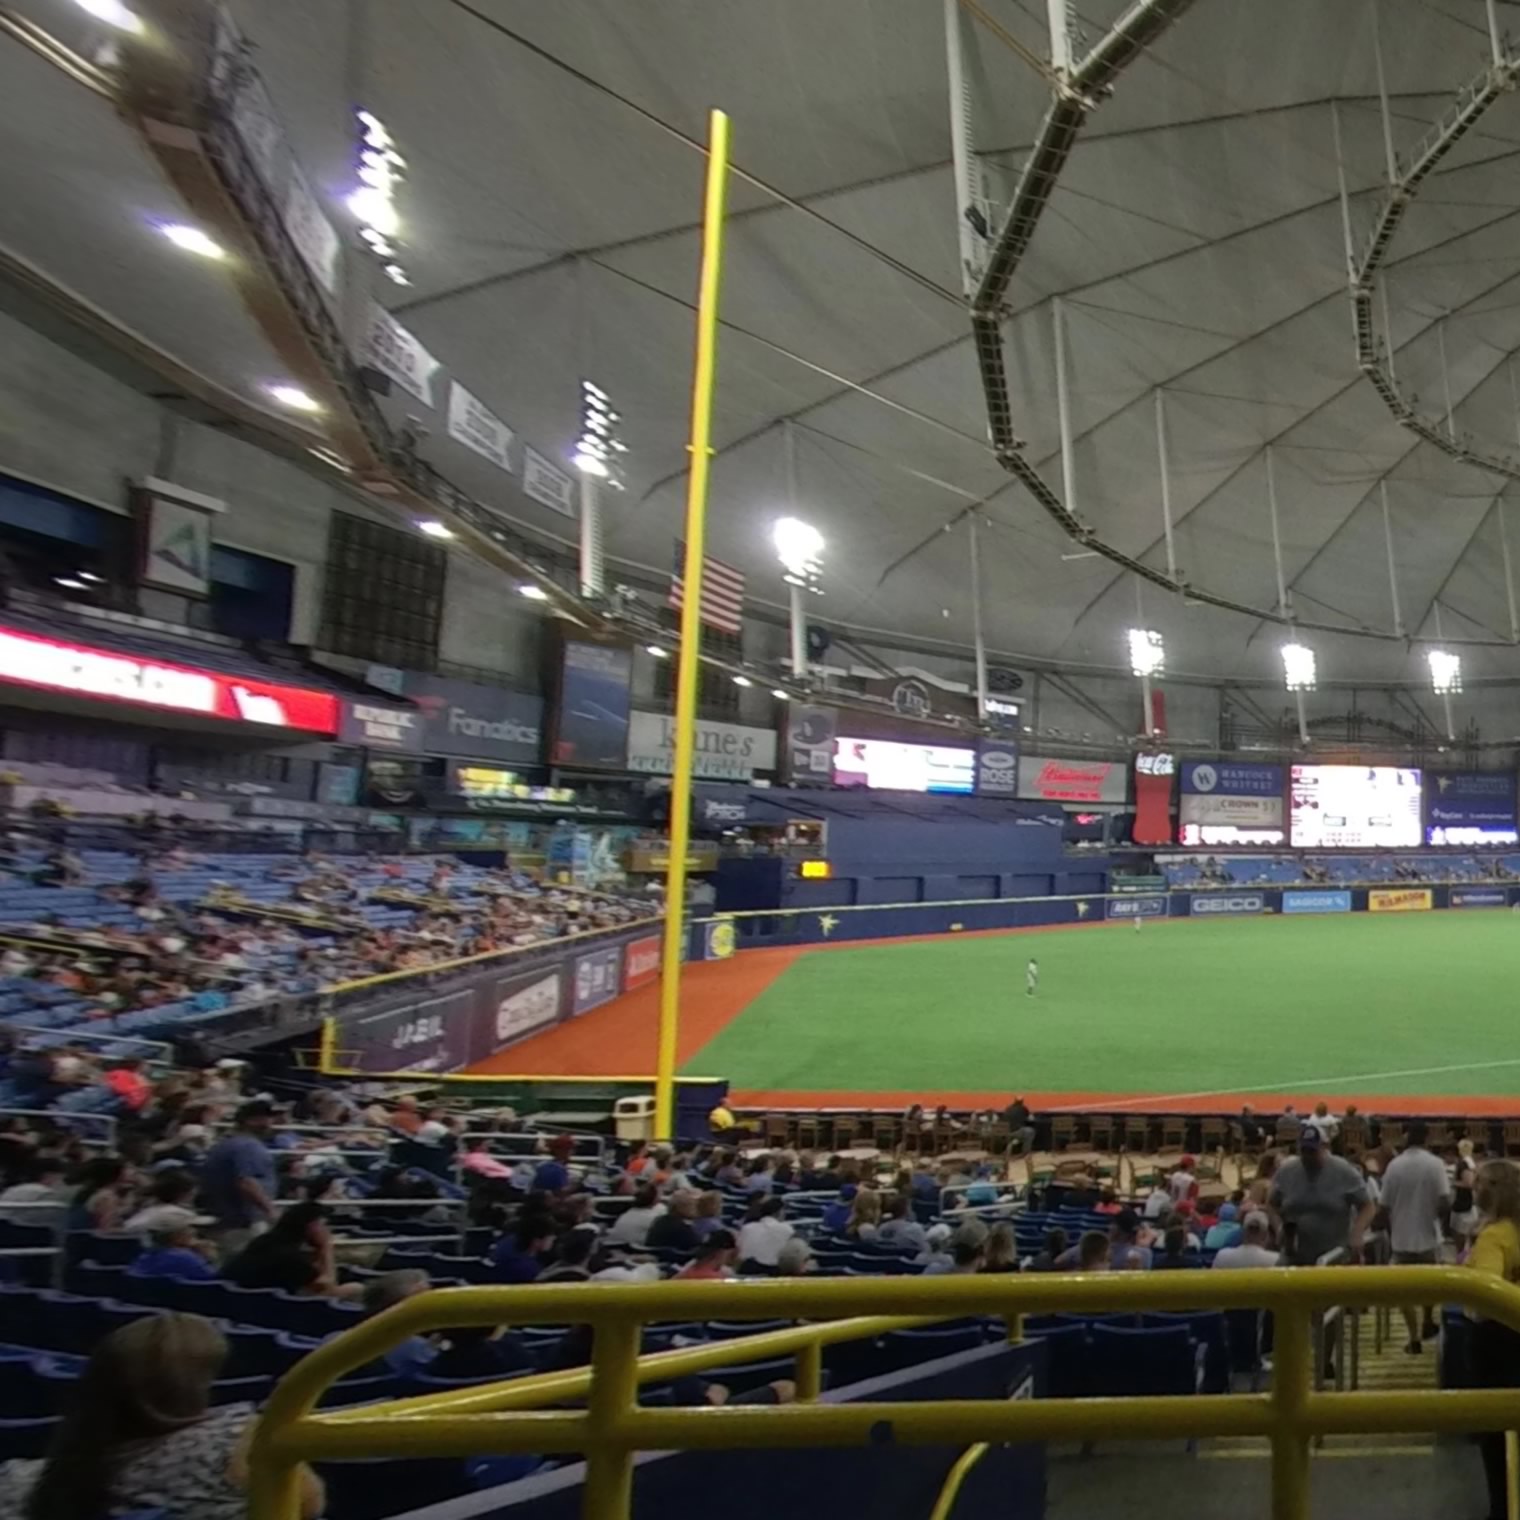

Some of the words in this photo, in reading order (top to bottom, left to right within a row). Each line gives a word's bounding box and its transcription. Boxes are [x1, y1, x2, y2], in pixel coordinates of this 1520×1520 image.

[450, 706, 539, 745] Fanatics
[980, 769, 1015, 784] ROSE
[1222, 769, 1272, 780] HANCOCK
[1222, 780, 1272, 790] WHITNEY
[1220, 799, 1259, 810] CROWN
[1192, 897, 1260, 912] GEICO
